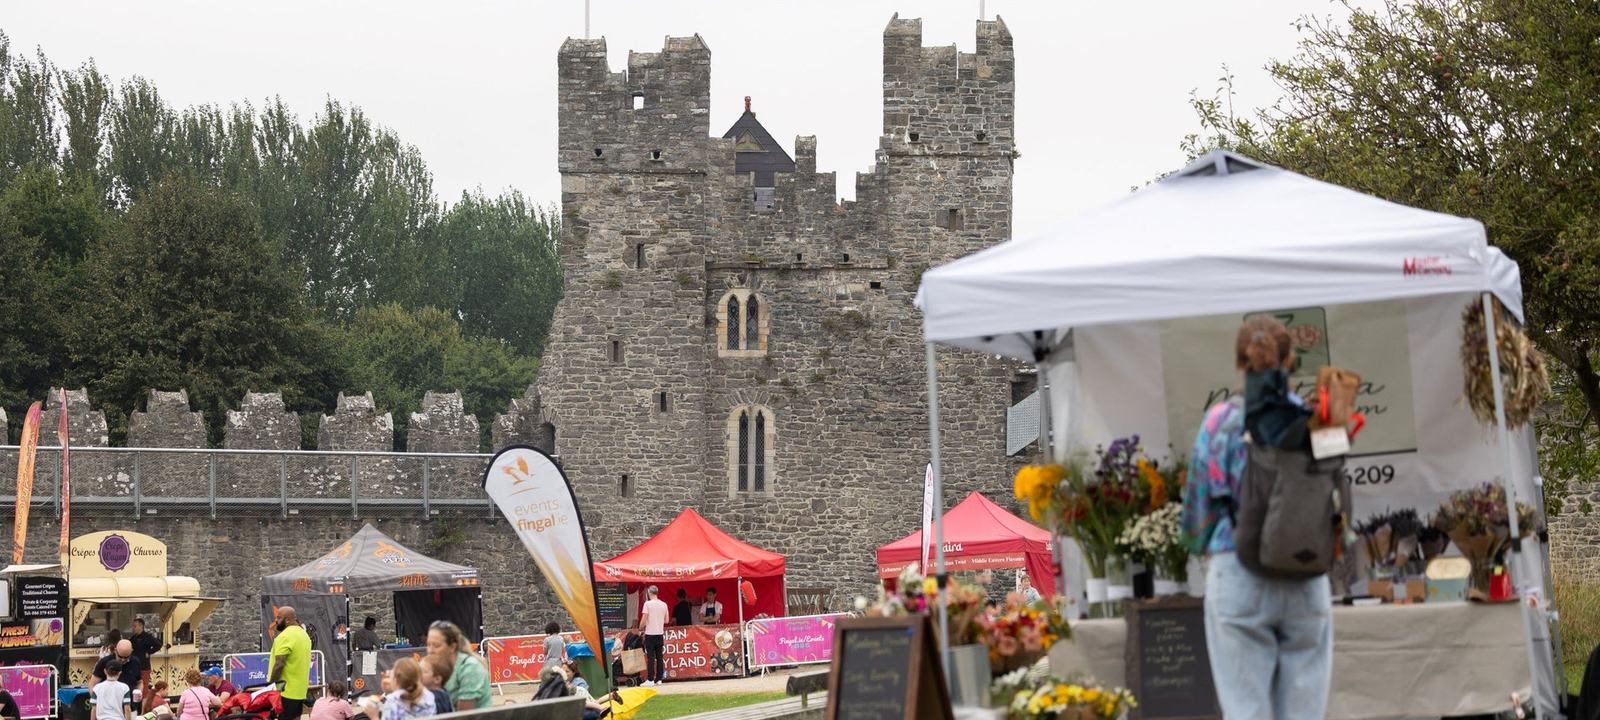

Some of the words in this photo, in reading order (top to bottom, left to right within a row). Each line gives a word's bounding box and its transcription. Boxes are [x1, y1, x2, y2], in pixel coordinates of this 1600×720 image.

[514, 499, 560, 516] events
[133, 546, 163, 557] Churros
[633, 568, 673, 577] NOODLE
[675, 567, 696, 576] BAR
[2, 625, 30, 637] FRESH
[509, 653, 535, 668] Fingal
